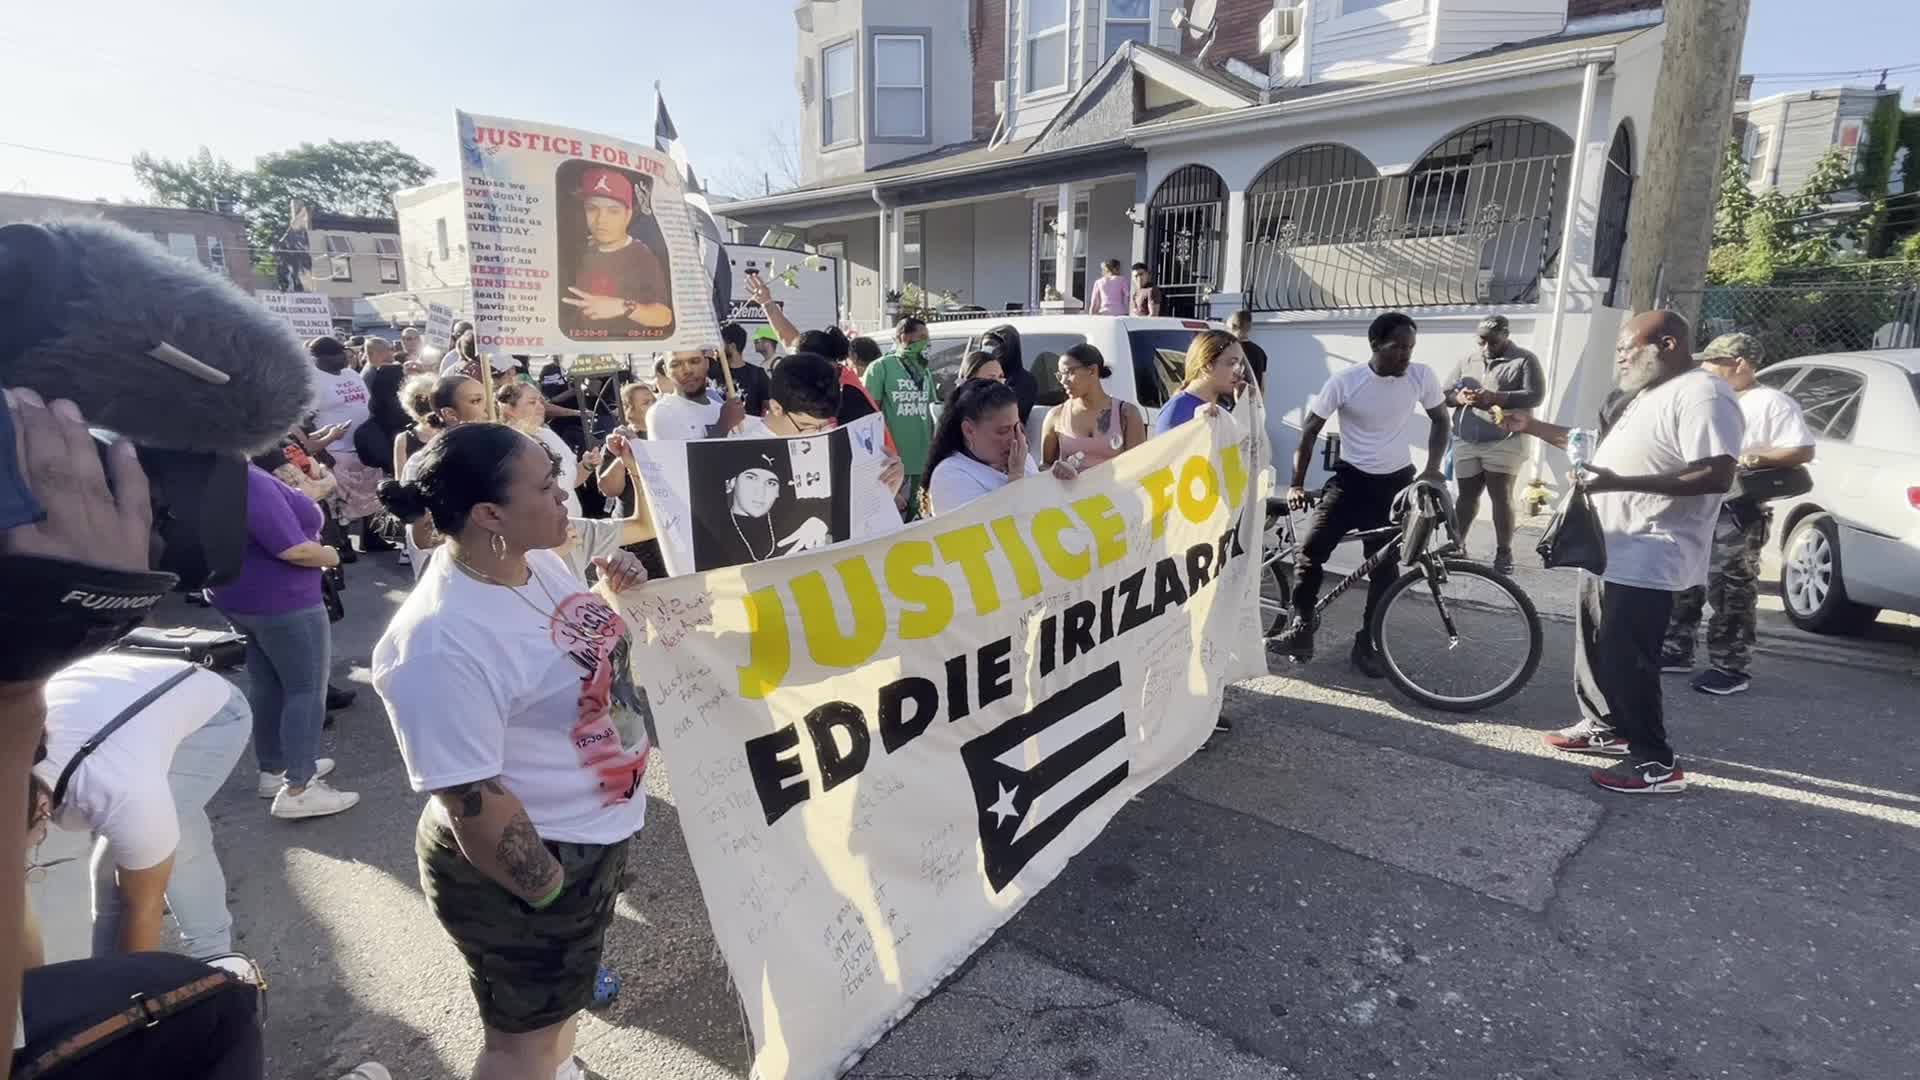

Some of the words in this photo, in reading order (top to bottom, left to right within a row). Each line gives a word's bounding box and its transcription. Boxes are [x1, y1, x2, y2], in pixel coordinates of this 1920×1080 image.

[473, 127, 583, 156] JUSTICE
[590, 144, 631, 168] FOR
[464, 187, 490, 198] OVE
[526, 196, 540, 205] go
[467, 211, 485, 221] alk
[506, 204, 531, 215] they
[470, 241, 491, 251] The
[495, 243, 537, 255] hardest
[475, 255, 501, 264] part
[503, 255, 516, 264] of
[471, 264, 550, 279] EXPECTED
[476, 301, 515, 313] having
[518, 303, 535, 312] the
[498, 325, 517, 334] say
[736, 493, 1130, 700] JUSTICE
[745, 635, 1015, 827] EDDIE
